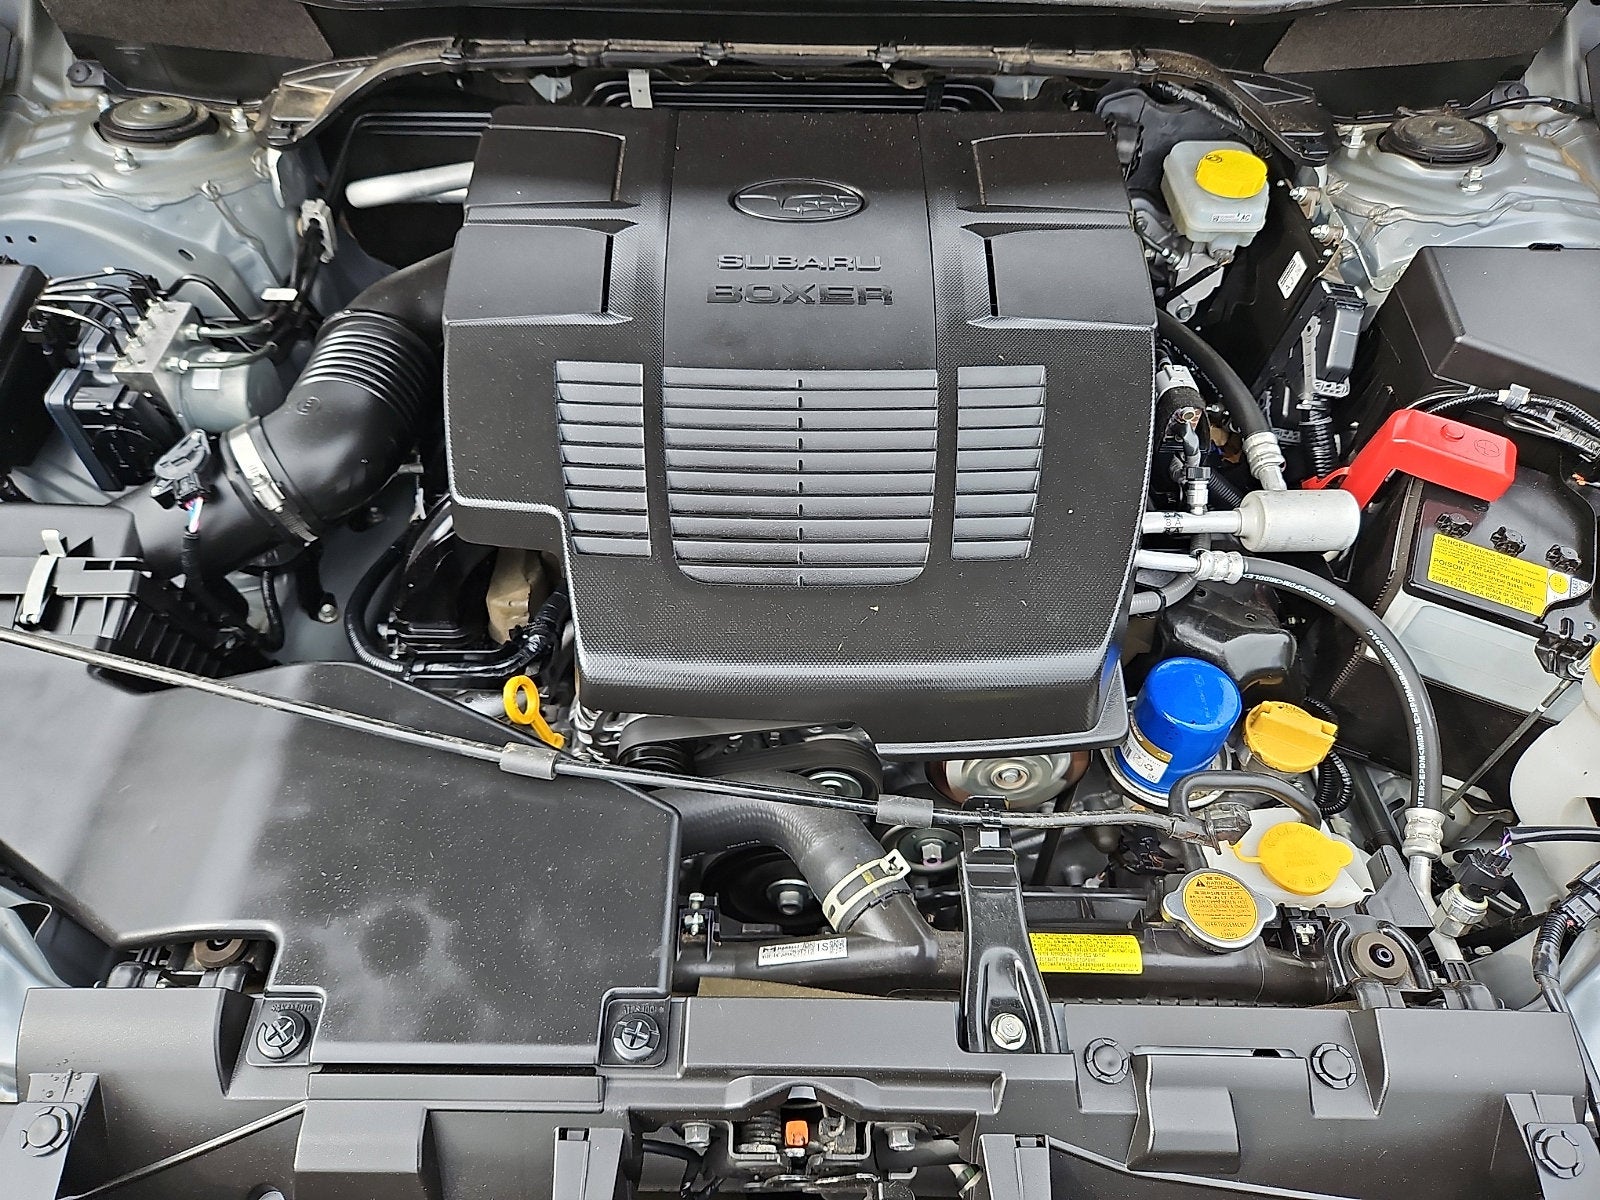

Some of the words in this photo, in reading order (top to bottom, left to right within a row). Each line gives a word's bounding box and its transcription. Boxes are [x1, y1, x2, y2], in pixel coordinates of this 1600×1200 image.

[717, 254, 882, 272] SUBARU
[706, 283, 894, 306] BOXER
[1436, 535, 1468, 550] DANGER
[1433, 557, 1464, 572] POISON
[1468, 569, 1487, 578] CAUSES
[1469, 586, 1484, 595] CCA
